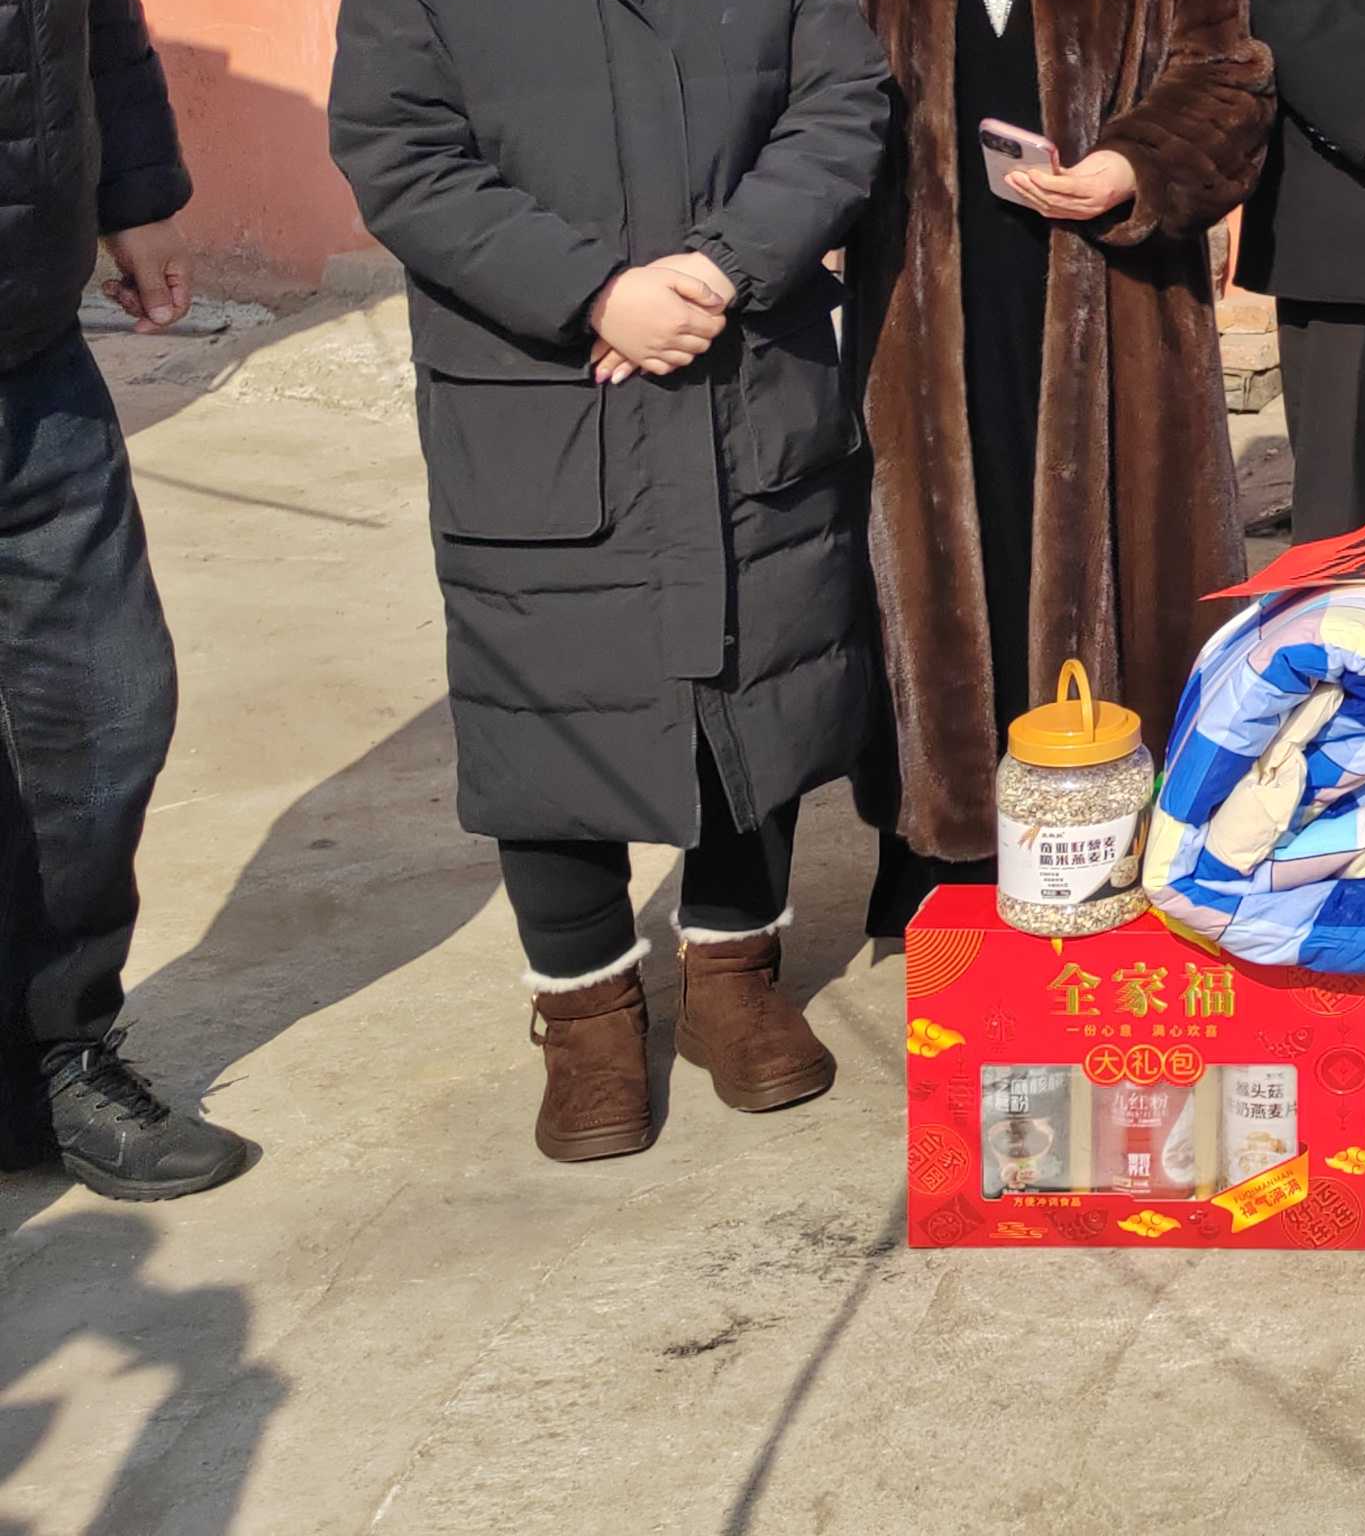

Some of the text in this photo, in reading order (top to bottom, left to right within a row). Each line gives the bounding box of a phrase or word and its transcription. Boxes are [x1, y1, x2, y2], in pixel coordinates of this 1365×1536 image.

[1046, 962, 1236, 1018] 全家福
[1066, 1024, 1218, 1038] 一份心意 满心欢喜
[1093, 1049, 1196, 1077] 大礼包
[1013, 1196, 1081, 1208] 方便冲调食品
[1239, 1178, 1302, 1219] 福气满满
